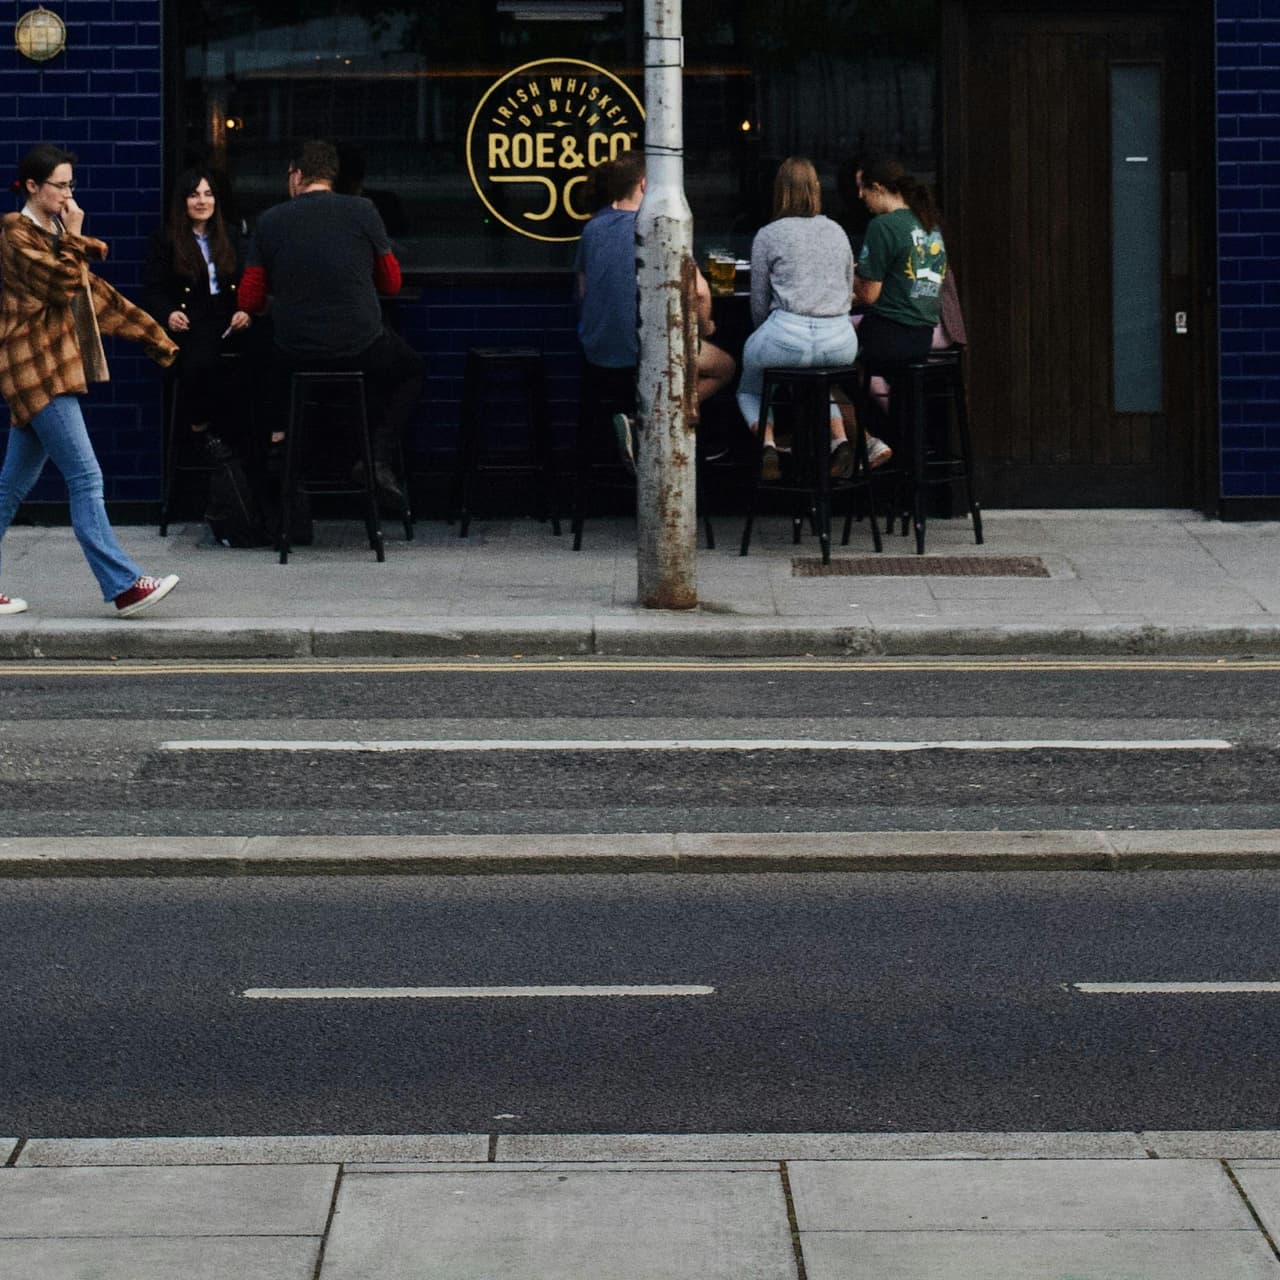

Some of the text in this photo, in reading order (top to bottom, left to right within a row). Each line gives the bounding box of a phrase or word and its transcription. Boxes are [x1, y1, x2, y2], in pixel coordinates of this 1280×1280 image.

[492, 77, 628, 126] IRISH WHISKEY
[518, 99, 600, 126] DUBLIN
